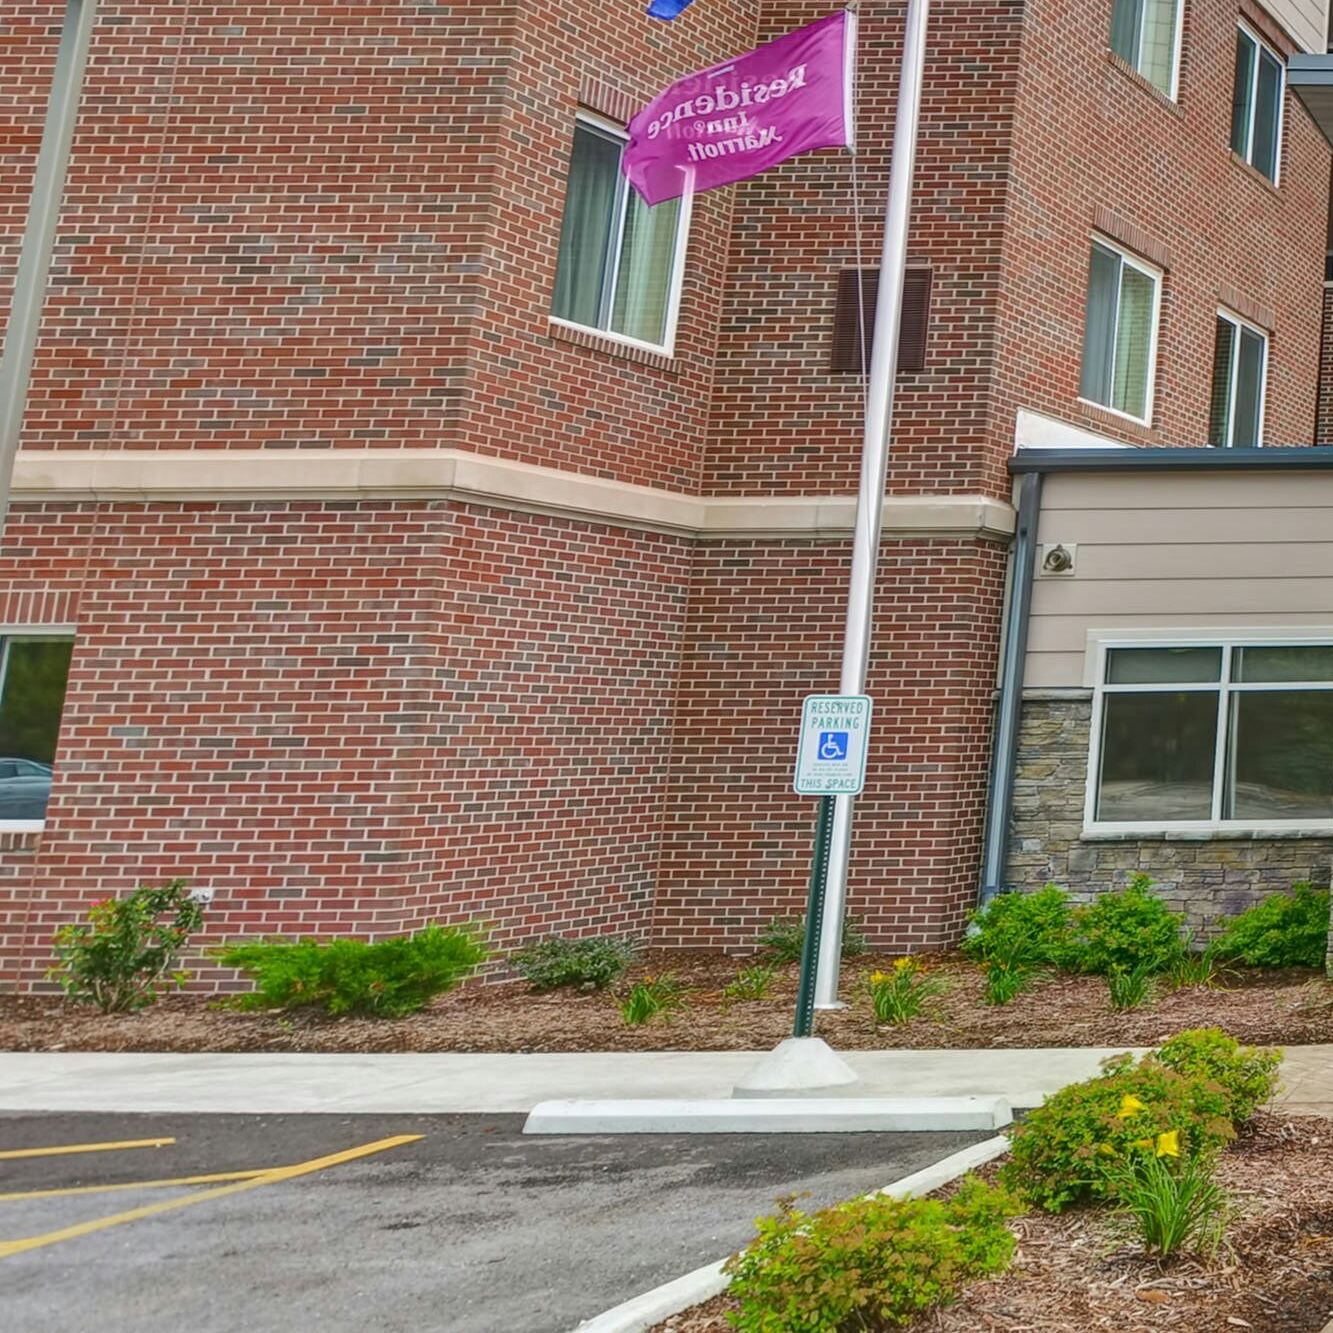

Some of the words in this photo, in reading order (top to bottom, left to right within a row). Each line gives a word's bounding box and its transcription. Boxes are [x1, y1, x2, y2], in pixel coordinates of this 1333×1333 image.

[810, 701, 864, 714] RESERVED
[811, 717, 860, 729] PARKING
[800, 778, 822, 788] THIS
[825, 778, 857, 789] SPACE
